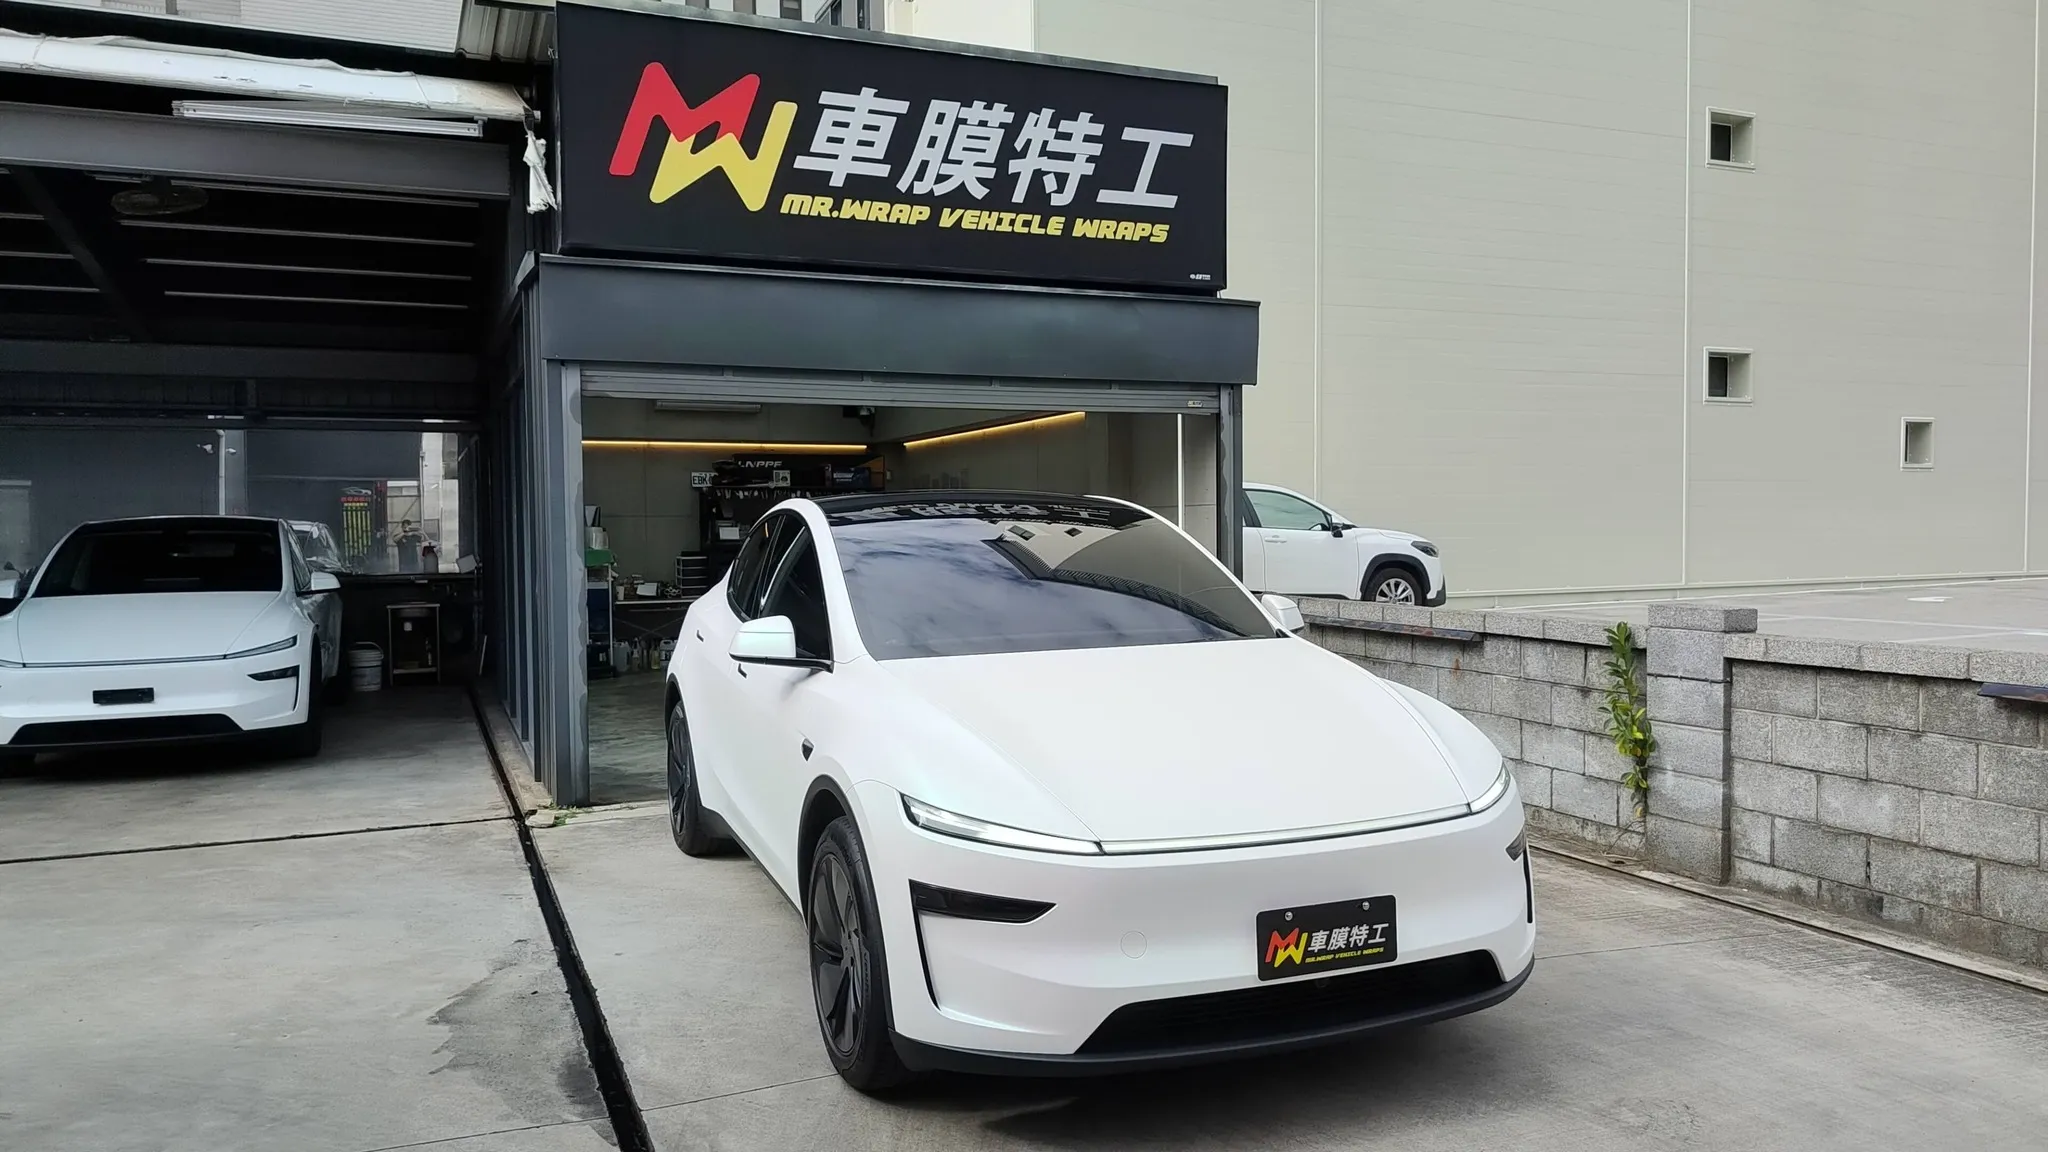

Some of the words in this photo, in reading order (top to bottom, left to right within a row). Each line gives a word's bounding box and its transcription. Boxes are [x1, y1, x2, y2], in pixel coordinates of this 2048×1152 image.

[793, 86, 1194, 208] 車膜特工
[780, 194, 931, 225] MR.WRAP
[938, 208, 1066, 236] VEHICLE
[1072, 218, 1170, 243] WRAPS
[1307, 923, 1389, 953] 車膜特工
